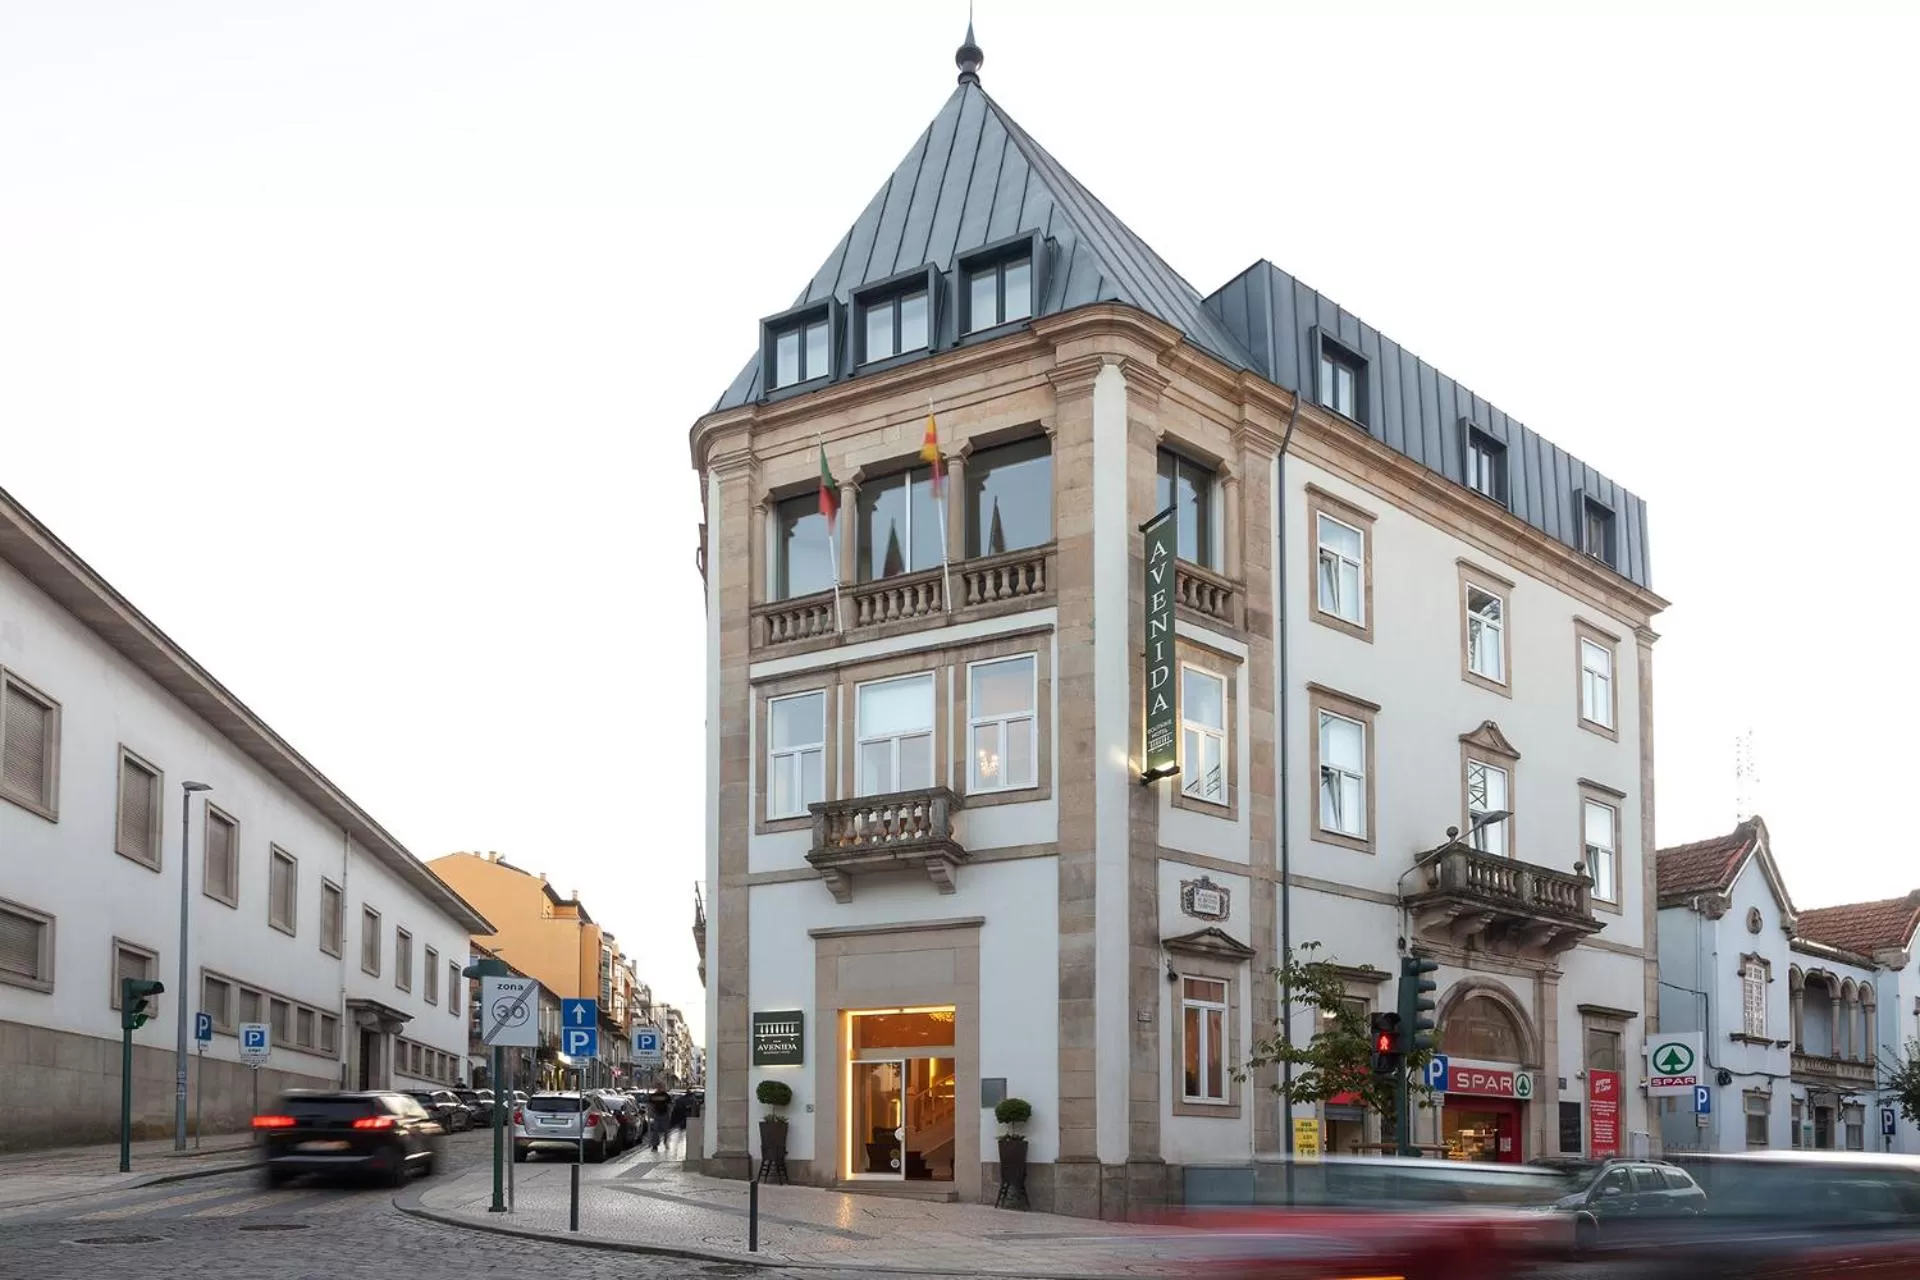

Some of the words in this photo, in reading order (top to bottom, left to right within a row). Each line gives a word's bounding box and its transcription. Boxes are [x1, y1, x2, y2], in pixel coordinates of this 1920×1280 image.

[1150, 540, 1168, 717] AVENIDA
[497, 983, 524, 991] zona
[199, 1015, 208, 1037] P
[249, 1032, 260, 1046] P
[570, 1031, 590, 1055] P
[641, 1036, 653, 1048] P
[757, 1043, 797, 1051] AVENIDA
[1429, 1058, 1443, 1086] P
[1456, 1072, 1513, 1092] SPAR
[1652, 1077, 1696, 1086] SPAR
[1697, 1088, 1708, 1111] P
[1884, 1111, 1893, 1133] P
